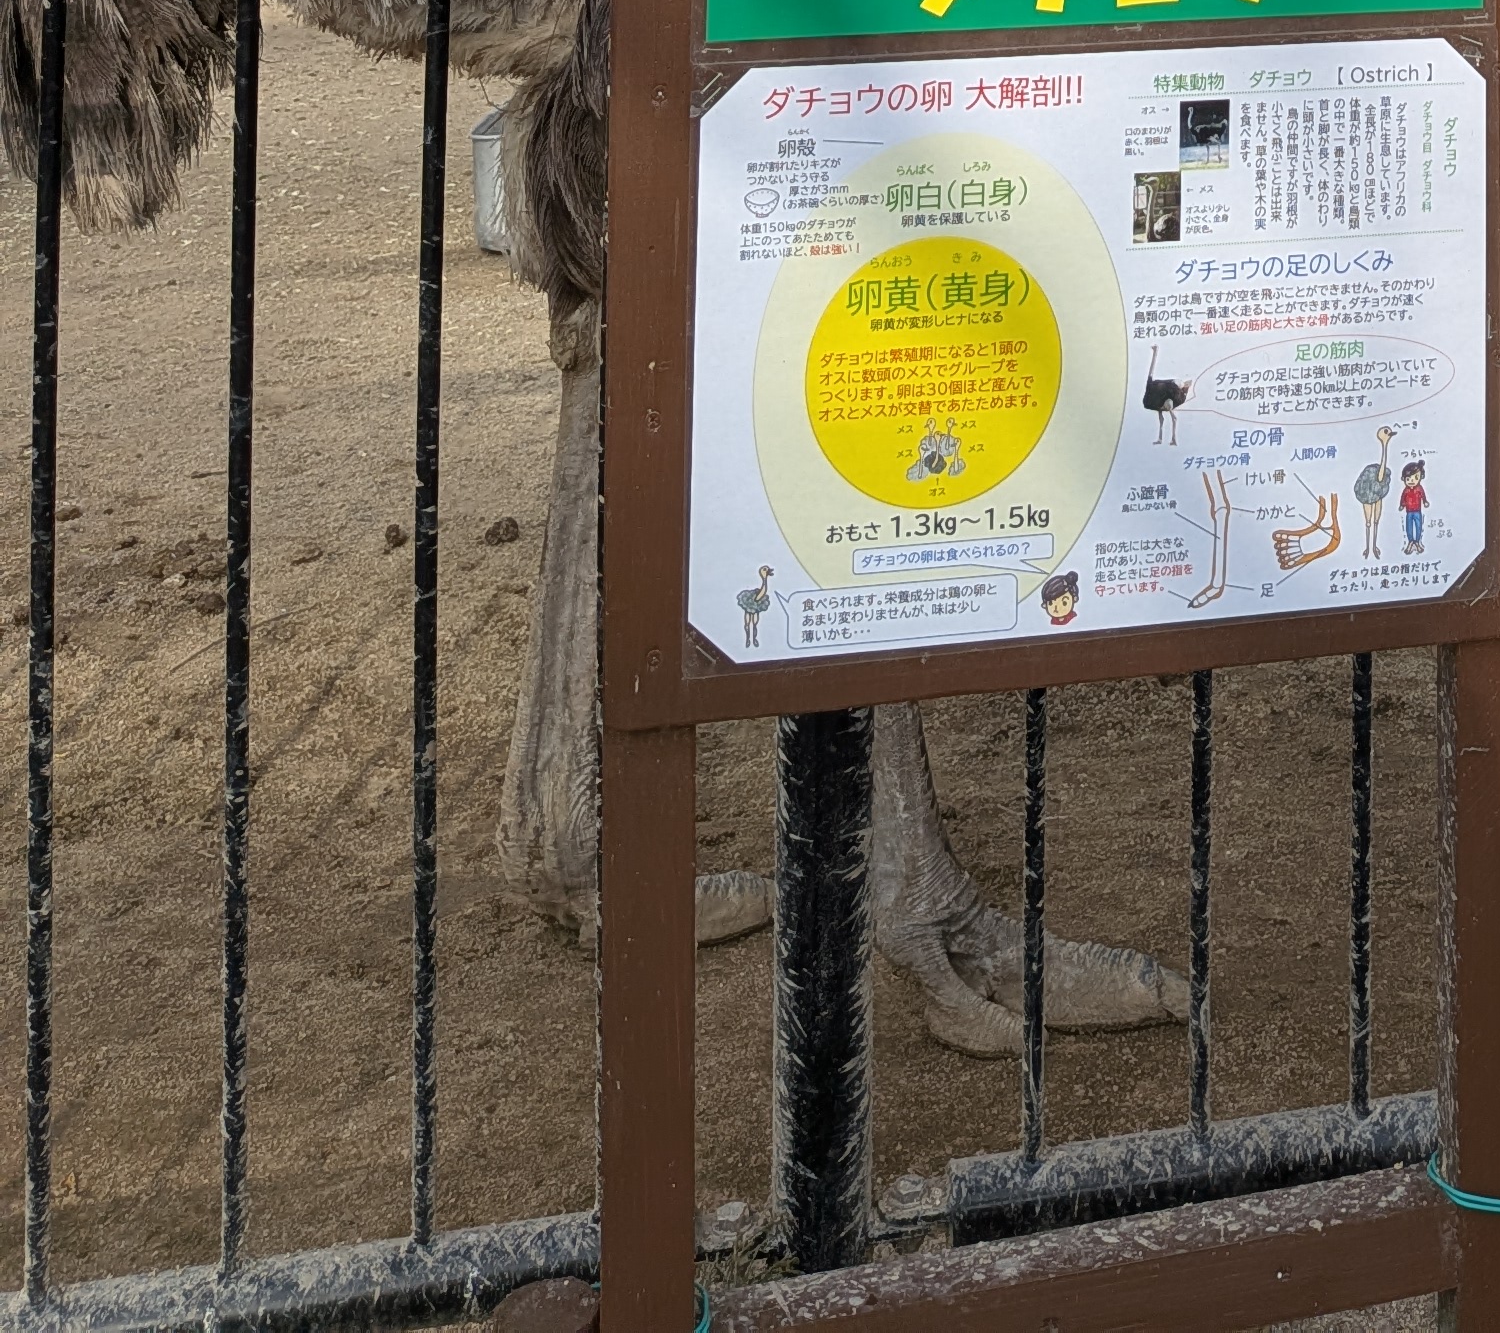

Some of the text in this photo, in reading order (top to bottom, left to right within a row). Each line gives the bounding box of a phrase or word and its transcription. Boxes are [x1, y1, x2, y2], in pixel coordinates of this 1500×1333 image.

[1153, 72, 1225, 94] 特集動物
[1249, 69, 1312, 89] ダチョウ
[1350, 65, 1419, 84] Ostrich
[763, 80, 952, 120] ダチョウの卵
[1240, 102, 1251, 168] を食べます。
[777, 138, 817, 159] 卵殻
[1302, 99, 1314, 201] に頭が小さいです。
[1421, 100, 1434, 212] ダチョウ目 ダチョウ科
[1443, 117, 1459, 178] ダチョウ
[746, 157, 842, 174] 卵が割れたりキズが
[896, 161, 991, 175] らんぱく しろみ
[1286, 107, 1299, 229] 鳥の仲間ですが羽根が
[1380, 96, 1392, 221] 草原に生息しています。
[1395, 102, 1407, 217] ダチョウはアフリカの
[746, 171, 830, 186] つかないよう守る
[788, 183, 849, 197] 厚さが3mm
[901, 209, 1011, 228] 卵黄を保護している
[740, 230, 855, 248] 上にのってあたためても
[870, 254, 912, 269] らんおう
[1175, 250, 1393, 284] ダチョウの足のしくみ
[1134, 277, 1435, 309] ダチョウは鳥ですが空を飛ぶことができません。そのかわり
[1133, 294, 1423, 324] 鳥類の中で一番速く走ることができます。ダチョウが速く
[870, 310, 1004, 332] 卵黄が変形しヒナになる
[1133, 313, 1413, 339] 走れるのは、強い足の筋肉と大きな骨があるからです。
[1294, 340, 1364, 362] 足の筋肉
[819, 359, 1018, 386] オスに数頭のメスでグループを
[1215, 357, 1437, 385] ダチョウの足には強い筋肉がついていて
[818, 394, 1038, 423] オスとメスが交替であたためます。
[1257, 395, 1373, 416] 出すことができます。
[897, 420, 977, 434] メス メス
[1231, 427, 1284, 448] 足の骨
[896, 444, 985, 459] メス メス
[1183, 446, 1337, 470] ダチョウの骨 人間の骨
[1245, 469, 1286, 486] けい骨
[929, 487, 946, 497] オス
[1256, 504, 1296, 521] かかと
[825, 522, 882, 544] おもさ
[1095, 536, 1184, 556] 指の先には大きな
[1095, 549, 1189, 570] 爪があり、この爪が
[1095, 564, 1194, 583] 走るときに足の指を
[1329, 560, 1442, 581] ダチョウは足の指だけで
[1095, 581, 1165, 597] 守っています。
[1260, 582, 1275, 598] 足
[1329, 573, 1451, 594] 立ったり、走ったりします
[802, 583, 998, 613] 食べられます。栄養成分は鶏の卵と
[801, 599, 981, 628] あまり変わりませんが、味は少し
